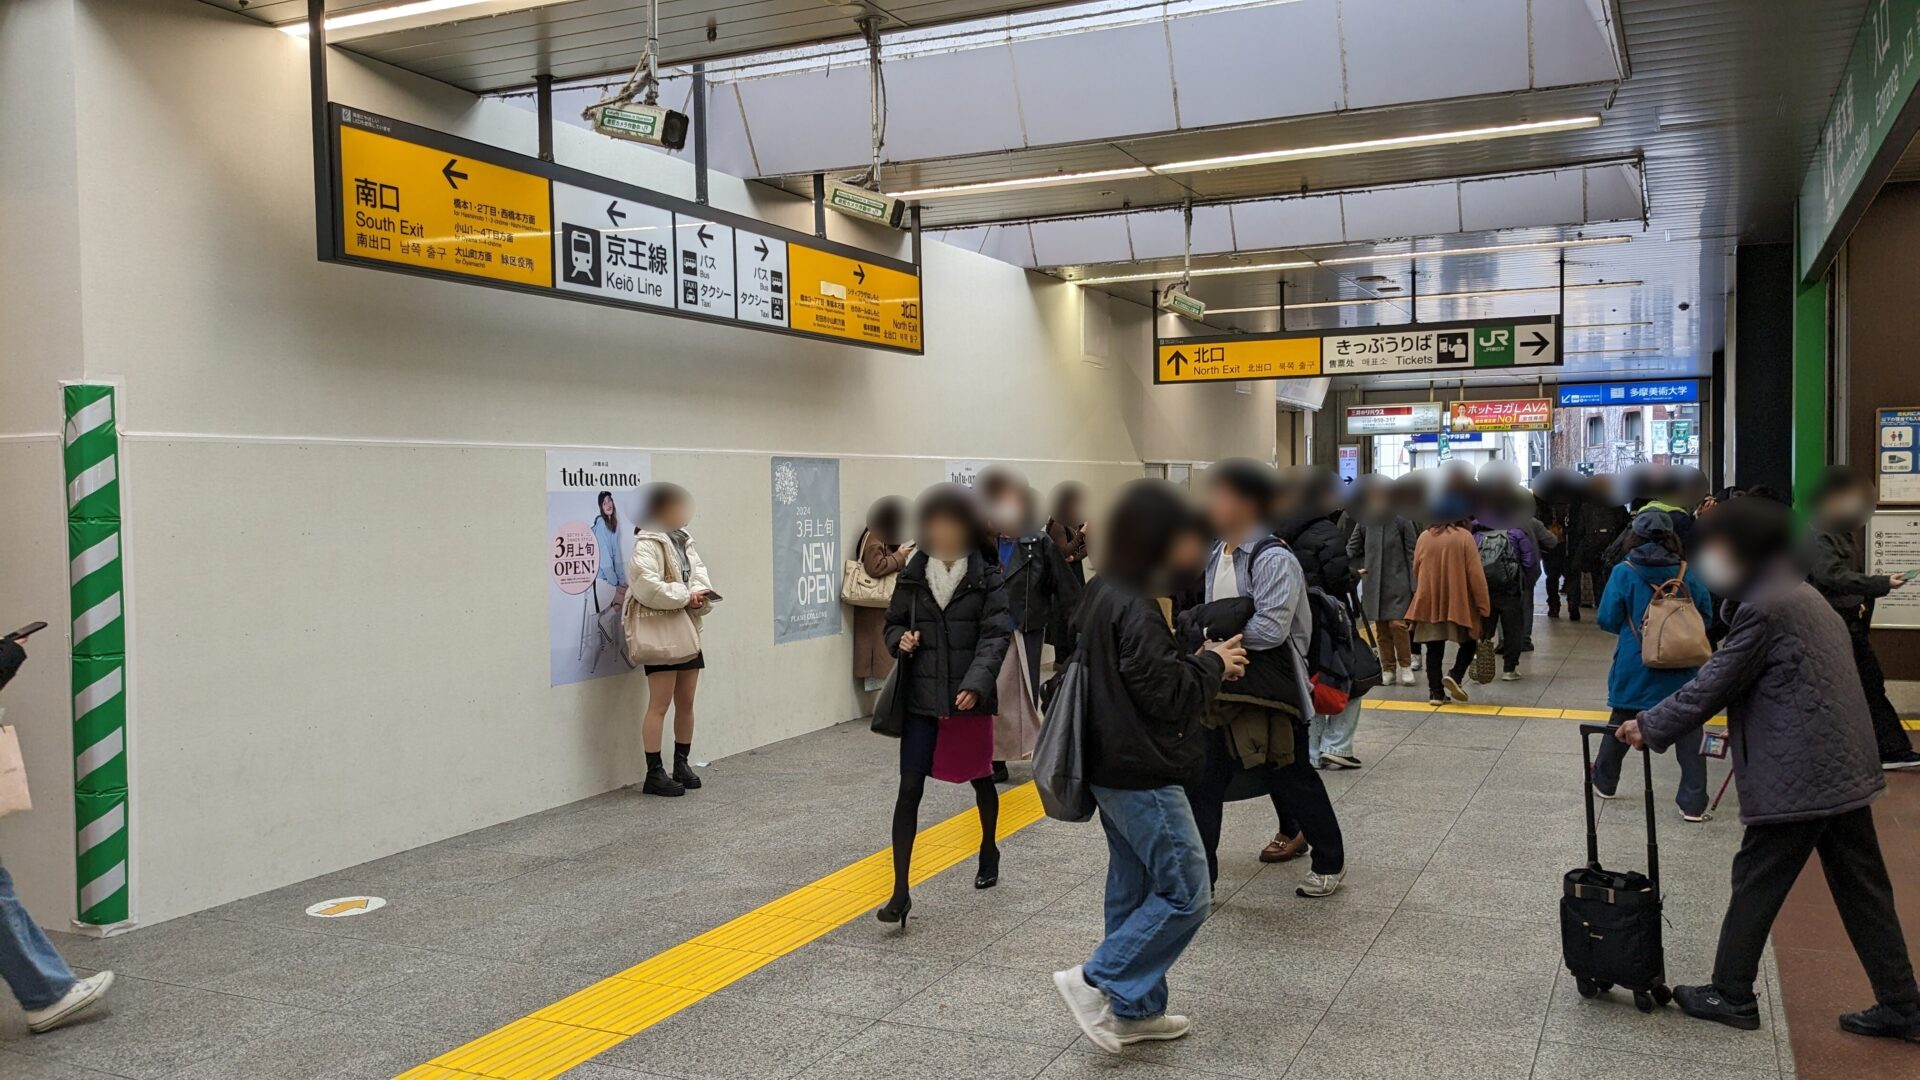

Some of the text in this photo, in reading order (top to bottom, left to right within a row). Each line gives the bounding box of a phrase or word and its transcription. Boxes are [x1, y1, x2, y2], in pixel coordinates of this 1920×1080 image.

[354, 177, 400, 213] 南口
[355, 210, 425, 238] South Exit
[356, 232, 391, 251] 南出口
[455, 246, 492, 262] 大山町方面
[605, 233, 668, 275] 京王線
[700, 255, 717, 270] バス
[700, 270, 710, 280] Bus
[753, 267, 769, 281] バス
[606, 270, 663, 297] Keiō Line
[700, 283, 732, 299] タクシー
[759, 283, 769, 292] Bus
[701, 299, 712, 308] Taxi
[740, 291, 770, 306] タクシー
[760, 309, 770, 319] Taxi
[901, 300, 917, 320] 北口
[892, 319, 907, 331] North
[1336, 334, 1433, 356] きっぷうりば
[1479, 330, 1509, 347] JR
[1194, 347, 1224, 364] 北口
[1395, 355, 1433, 366] Tickets
[1193, 364, 1240, 375] North Exit
[1248, 363, 1271, 373] 北出口
[1630, 385, 1688, 397] 多摩美術大学
[796, 506, 811, 516] 2024
[796, 517, 834, 538] 3月上旬
[554, 536, 595, 559] 3月上旬
[802, 541, 834, 574] NEW
[554, 559, 595, 577] OPEN!
[797, 573, 835, 606] OPEN
